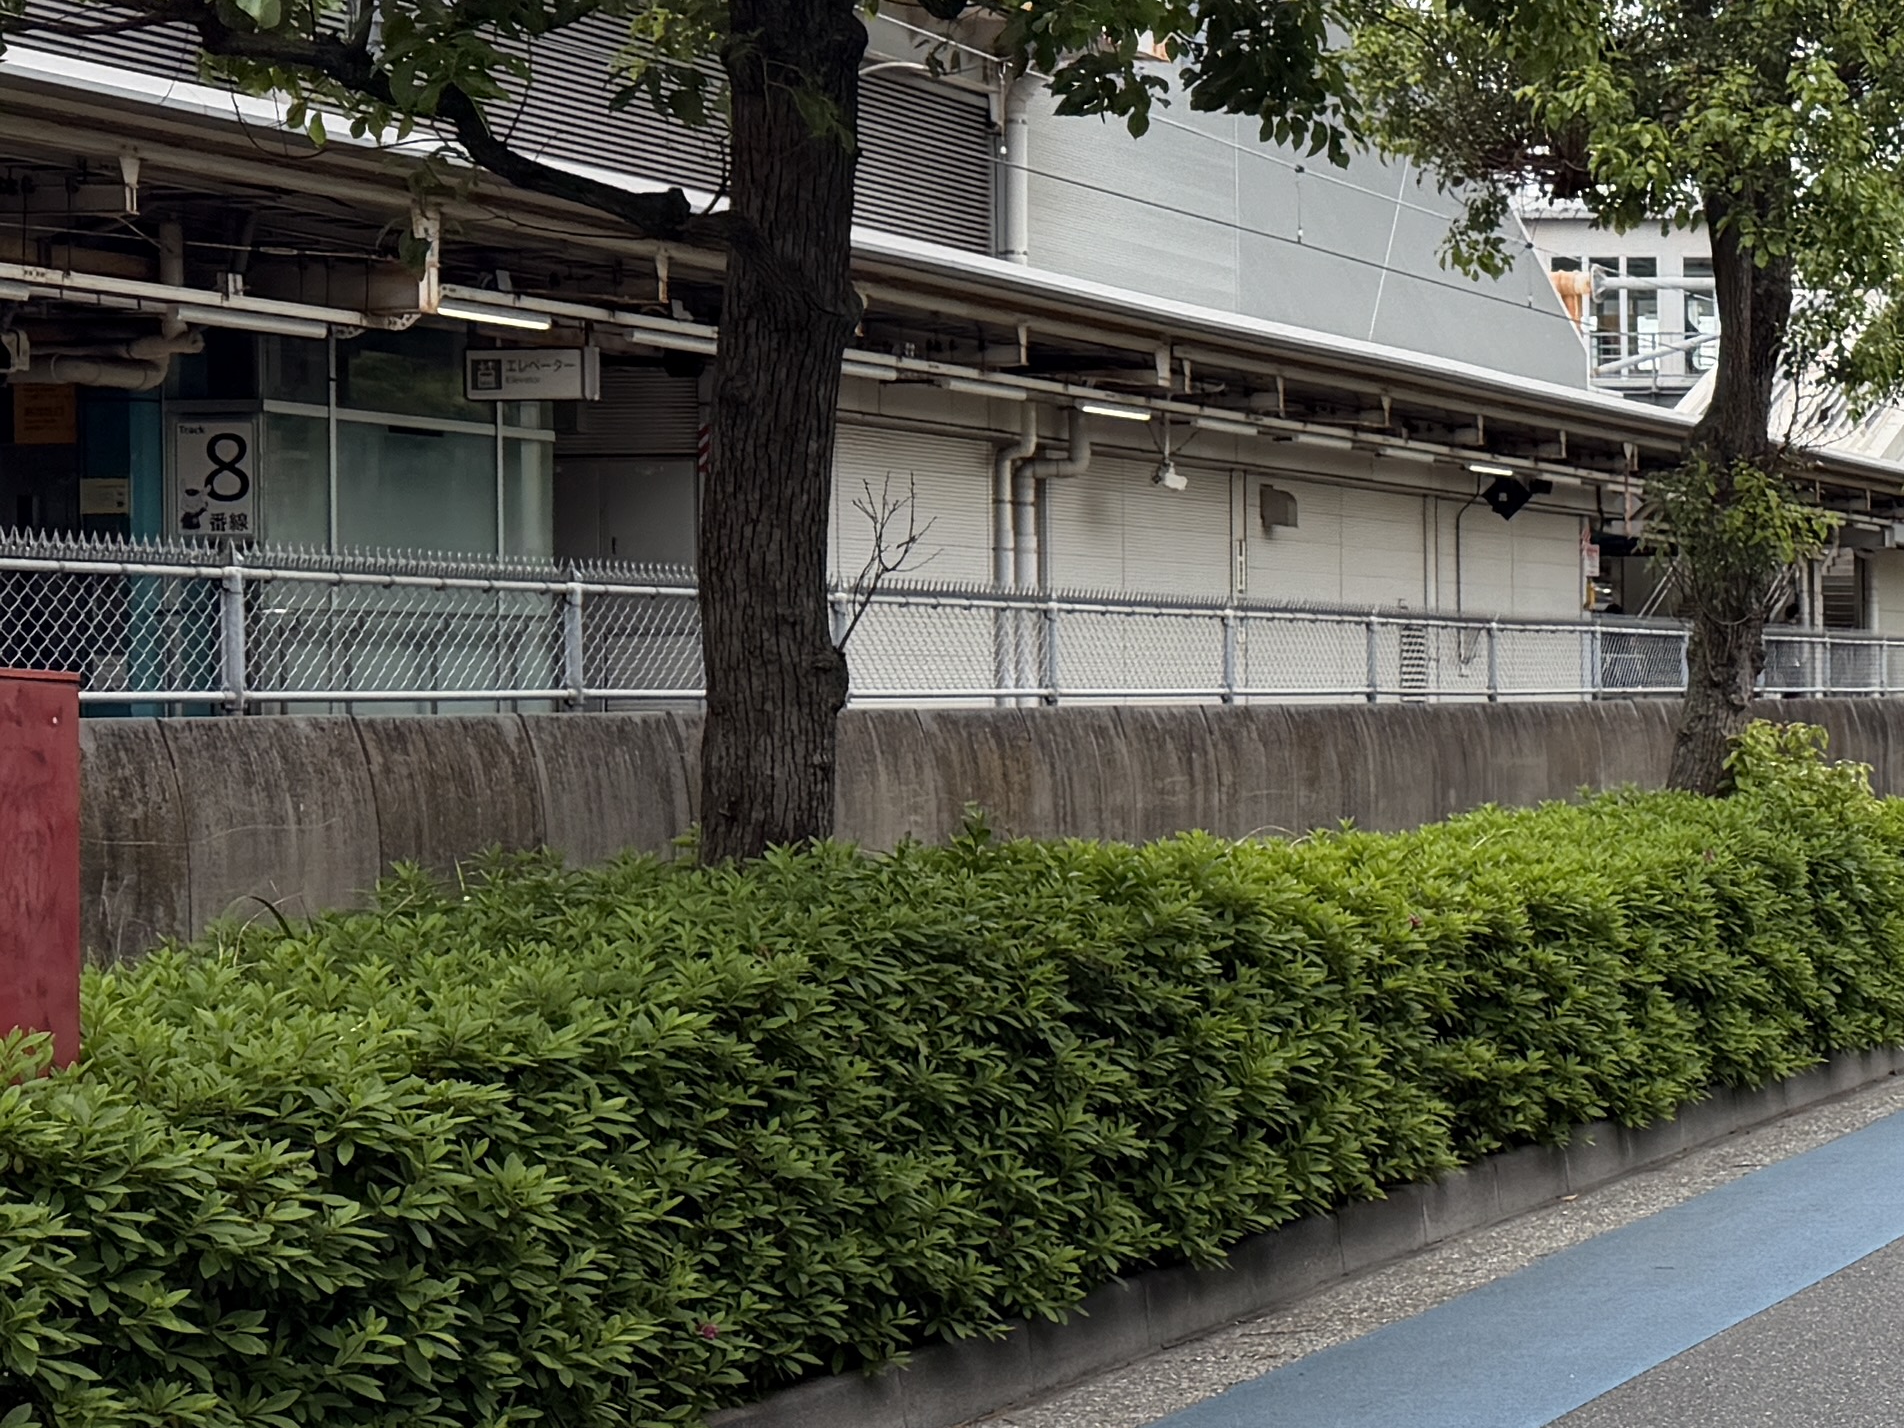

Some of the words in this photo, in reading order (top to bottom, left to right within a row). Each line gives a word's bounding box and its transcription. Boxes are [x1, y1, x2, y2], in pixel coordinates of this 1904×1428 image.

[506, 358, 577, 373] エレベーター
[179, 425, 204, 434] Track
[204, 432, 250, 502] 8
[209, 512, 248, 532] 番線
